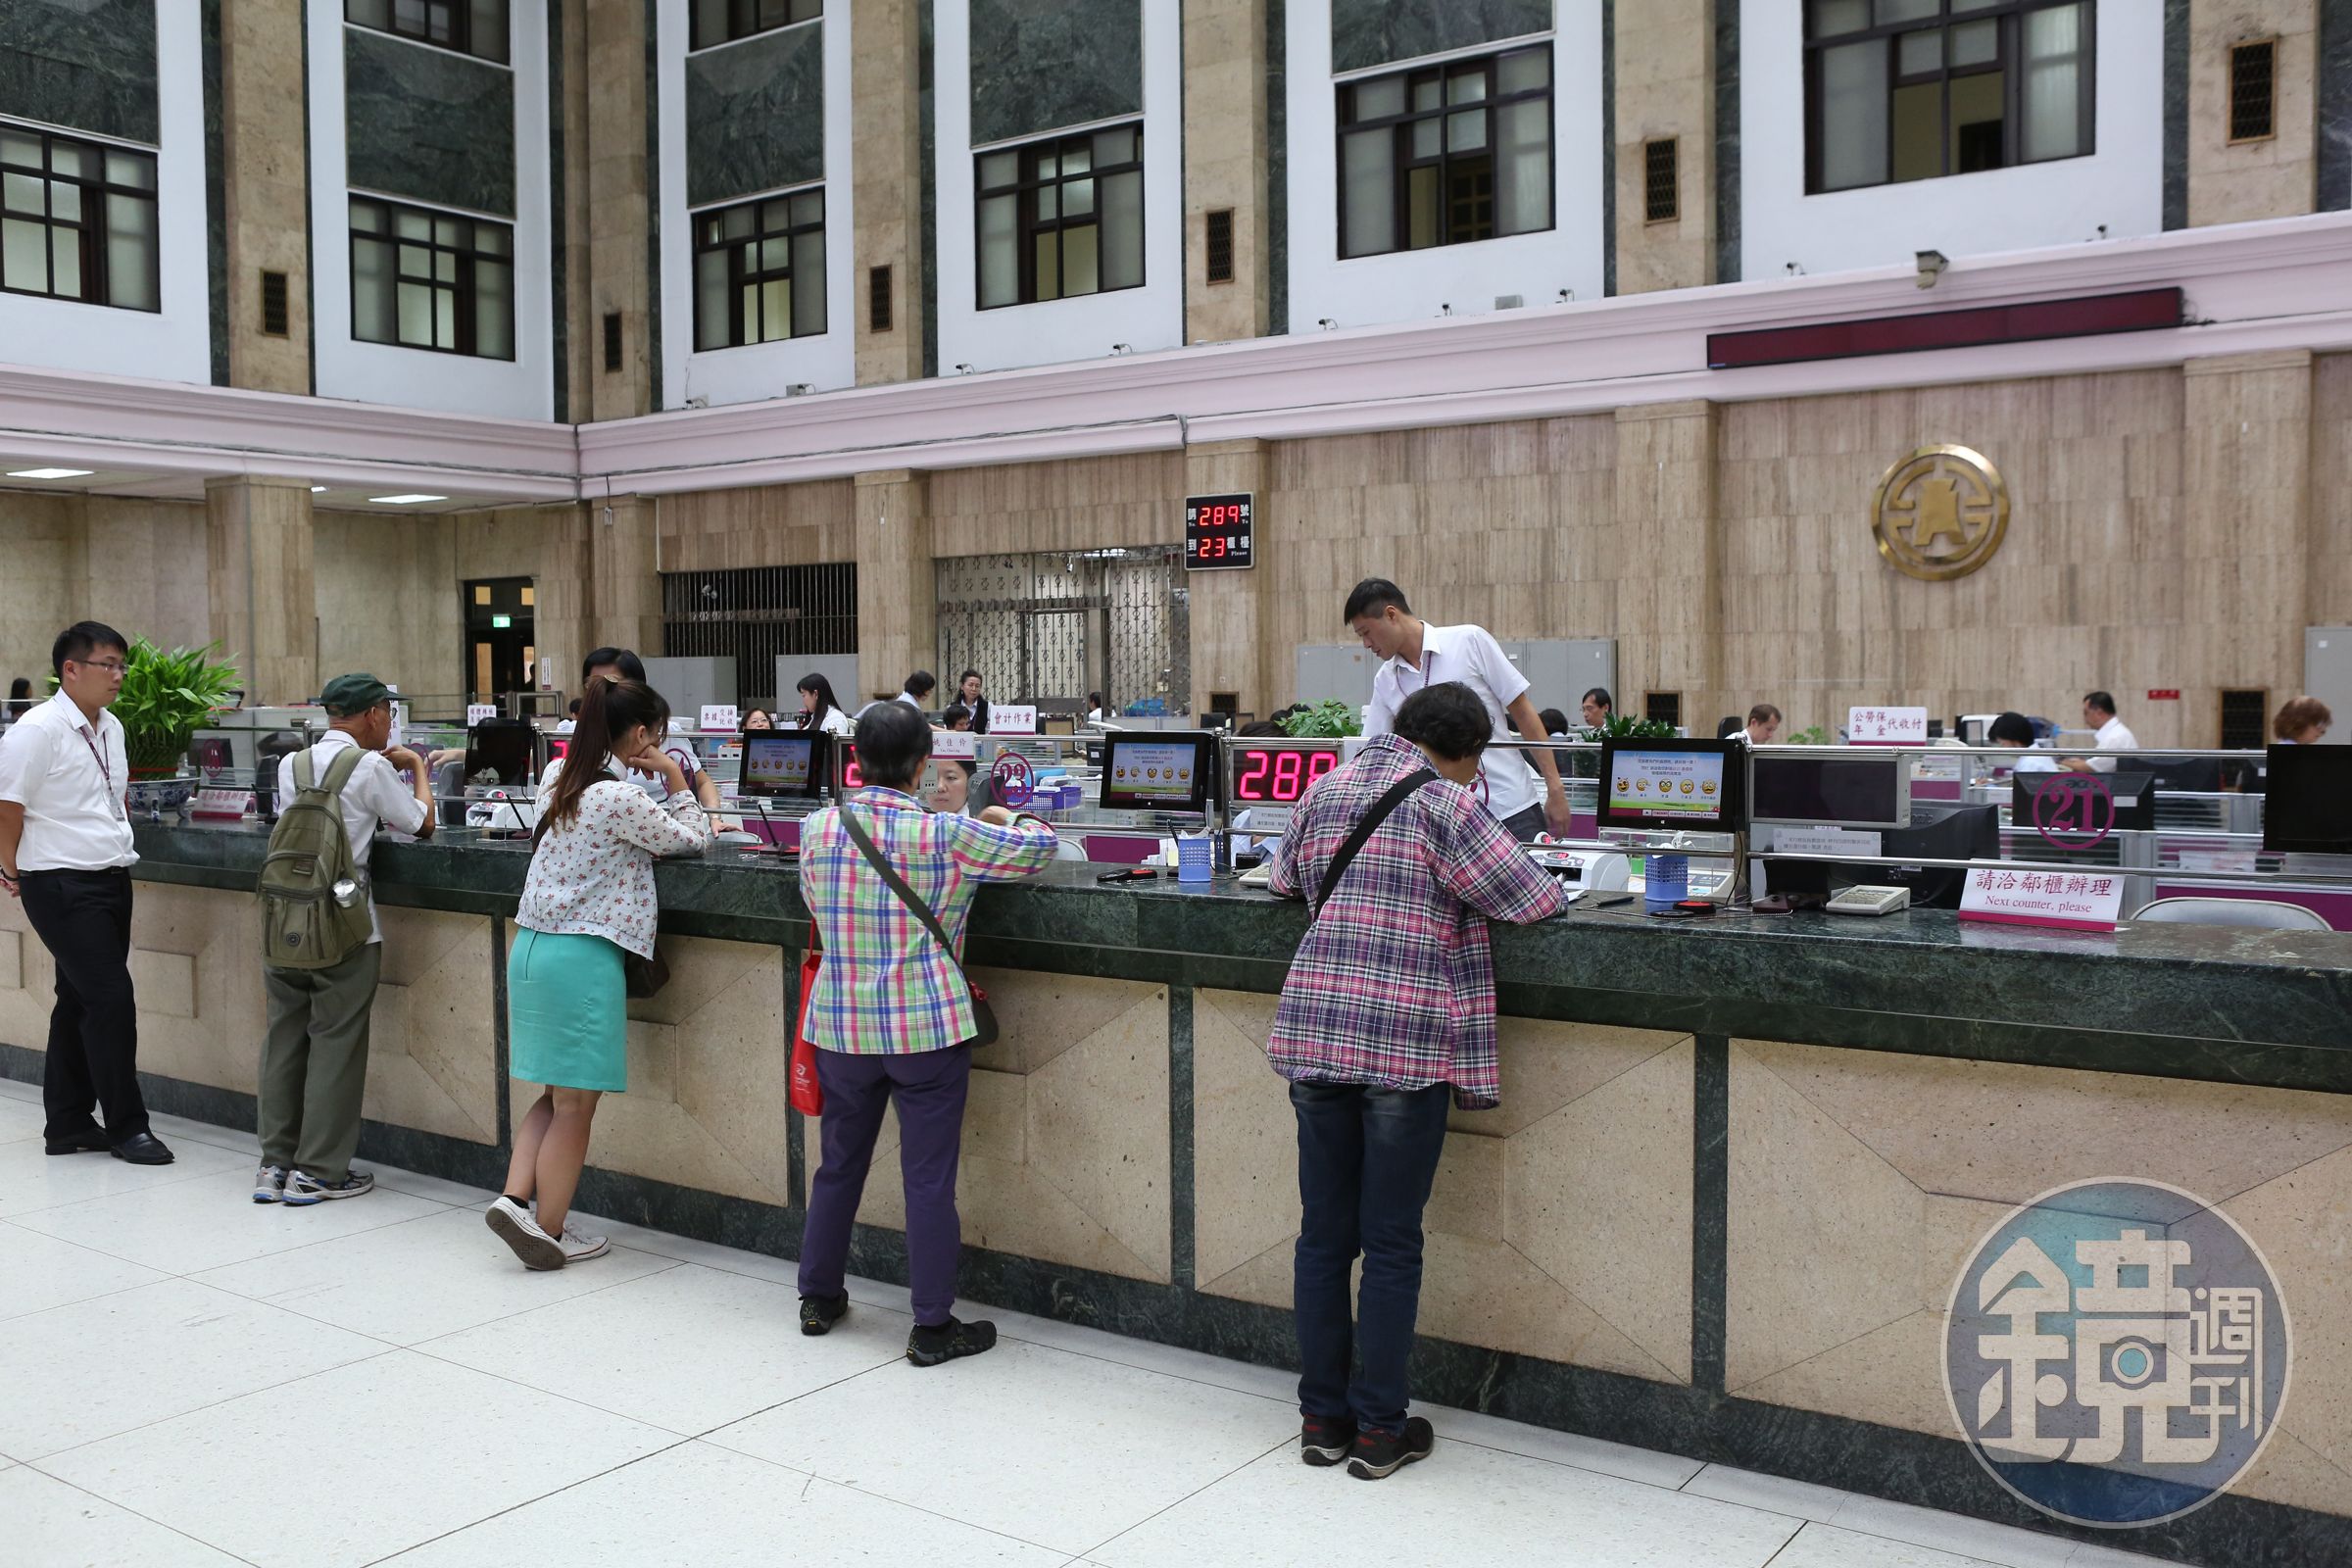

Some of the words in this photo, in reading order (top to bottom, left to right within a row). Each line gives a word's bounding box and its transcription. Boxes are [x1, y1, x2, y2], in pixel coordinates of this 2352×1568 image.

[1200, 506, 1239, 525] 289
[1200, 538, 1225, 558] 23
[994, 711, 1033, 725] 會計作業
[1887, 717, 1922, 730] 代收付
[1000, 763, 1027, 797] 23
[2049, 785, 2097, 832] 21
[1976, 869, 2112, 897] 請洽鄰櫃辦理
[1984, 895, 2009, 906] Next
[2058, 901, 2092, 913] please
